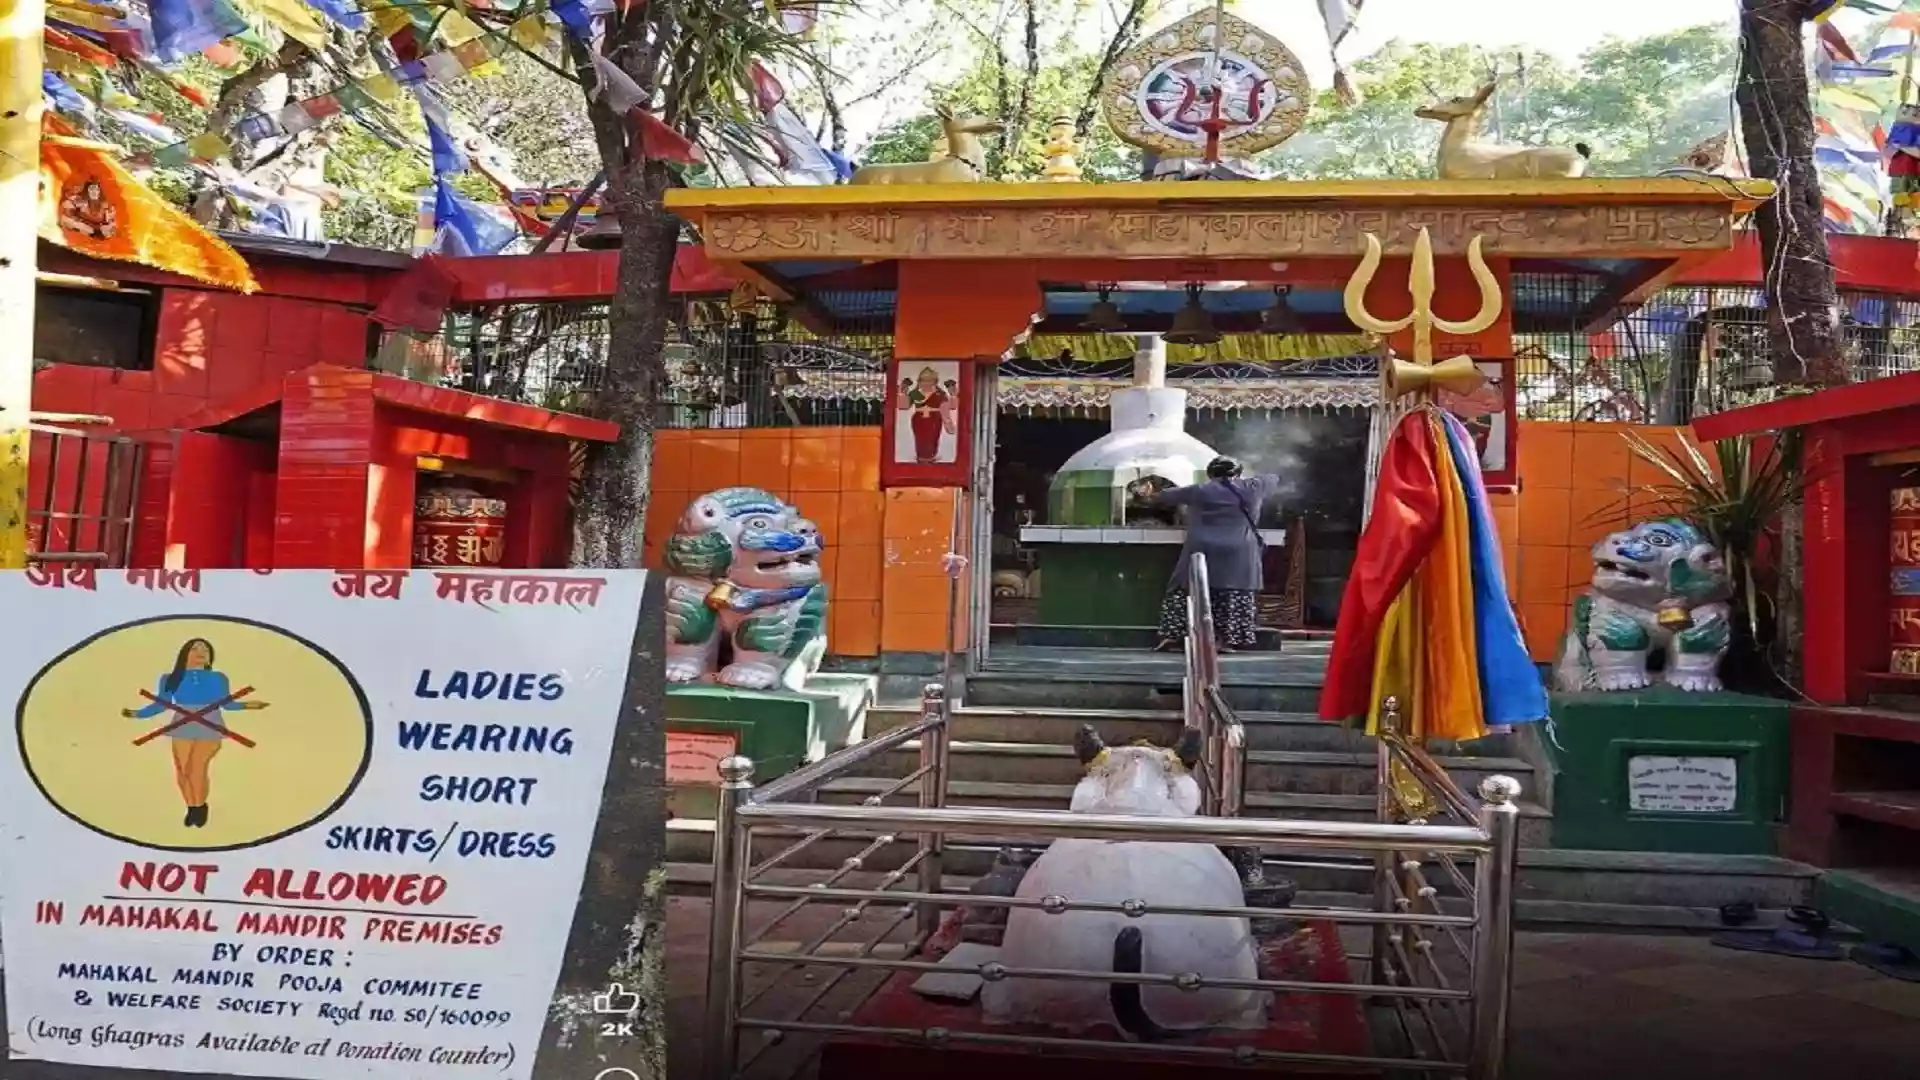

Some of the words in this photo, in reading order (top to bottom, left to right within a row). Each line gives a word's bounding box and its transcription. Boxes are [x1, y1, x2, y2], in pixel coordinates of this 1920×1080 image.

[332, 569, 409, 600] जय
[434, 572, 607, 613] महाकाल
[414, 669, 564, 701] LADIES
[398, 720, 574, 755] WEARING
[419, 774, 538, 806] SHORT
[119, 861, 219, 894] NOT
[243, 867, 447, 906] ALLOWED
[36, 901, 64, 925] IN
[80, 904, 219, 933] MAHAKAL
[236, 912, 347, 940] MANDIR
[363, 917, 504, 946] PREMISES
[212, 942, 244, 963] BY
[58, 963, 158, 983] MAHAKAL
[172, 969, 254, 988] MANDIR
[279, 973, 343, 994] POOJA
[363, 978, 483, 1000] COMMITEE
[73, 989, 92, 1006] &
[108, 991, 201, 1010] WELFARE
[216, 997, 303, 1017] SOCIETY
[317, 1000, 364, 1026] Regd
[27, 1015, 82, 1044] (Long
[91, 1023, 185, 1050] Ghagras
[196, 1031, 300, 1056] Available
[336, 1040, 423, 1063] Donation
[428, 1040, 516, 1073] Counter)
